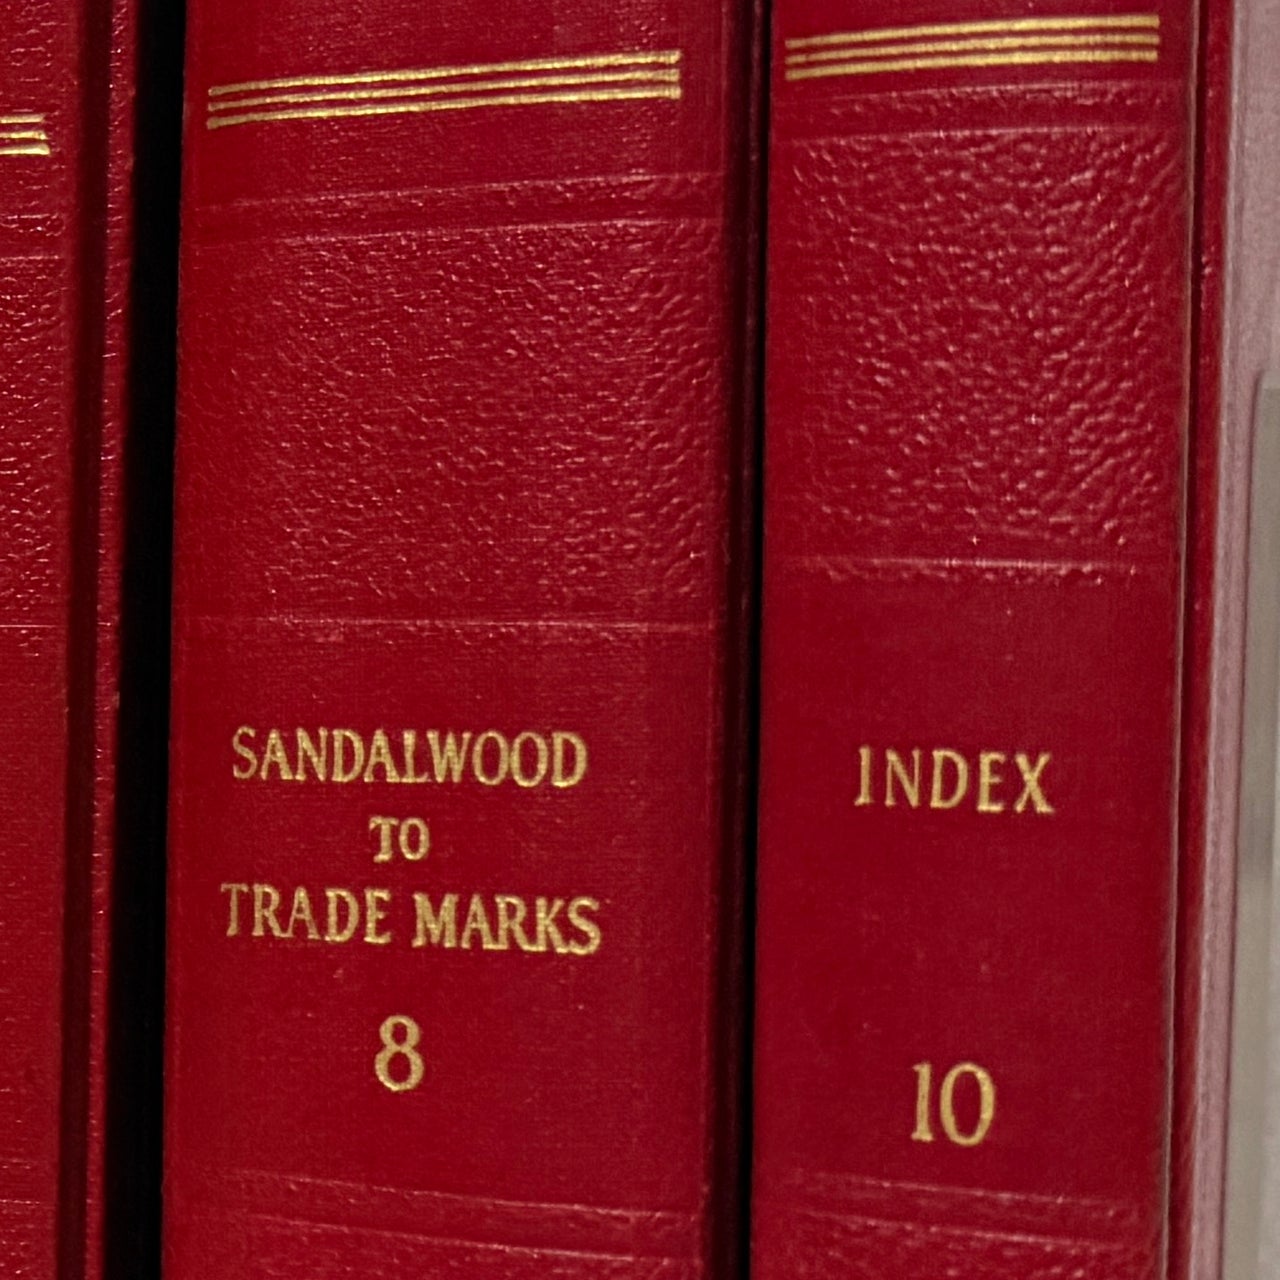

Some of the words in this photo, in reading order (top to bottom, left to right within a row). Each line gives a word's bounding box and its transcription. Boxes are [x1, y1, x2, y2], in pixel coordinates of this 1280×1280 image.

[232, 725, 589, 790] SANDALWOOD
[854, 745, 1054, 816] INDEX
[368, 815, 432, 865] TO
[220, 882, 393, 947] TRADE
[411, 891, 603, 958] MARKS
[374, 1014, 426, 1094] 8
[911, 1061, 997, 1148] 10
